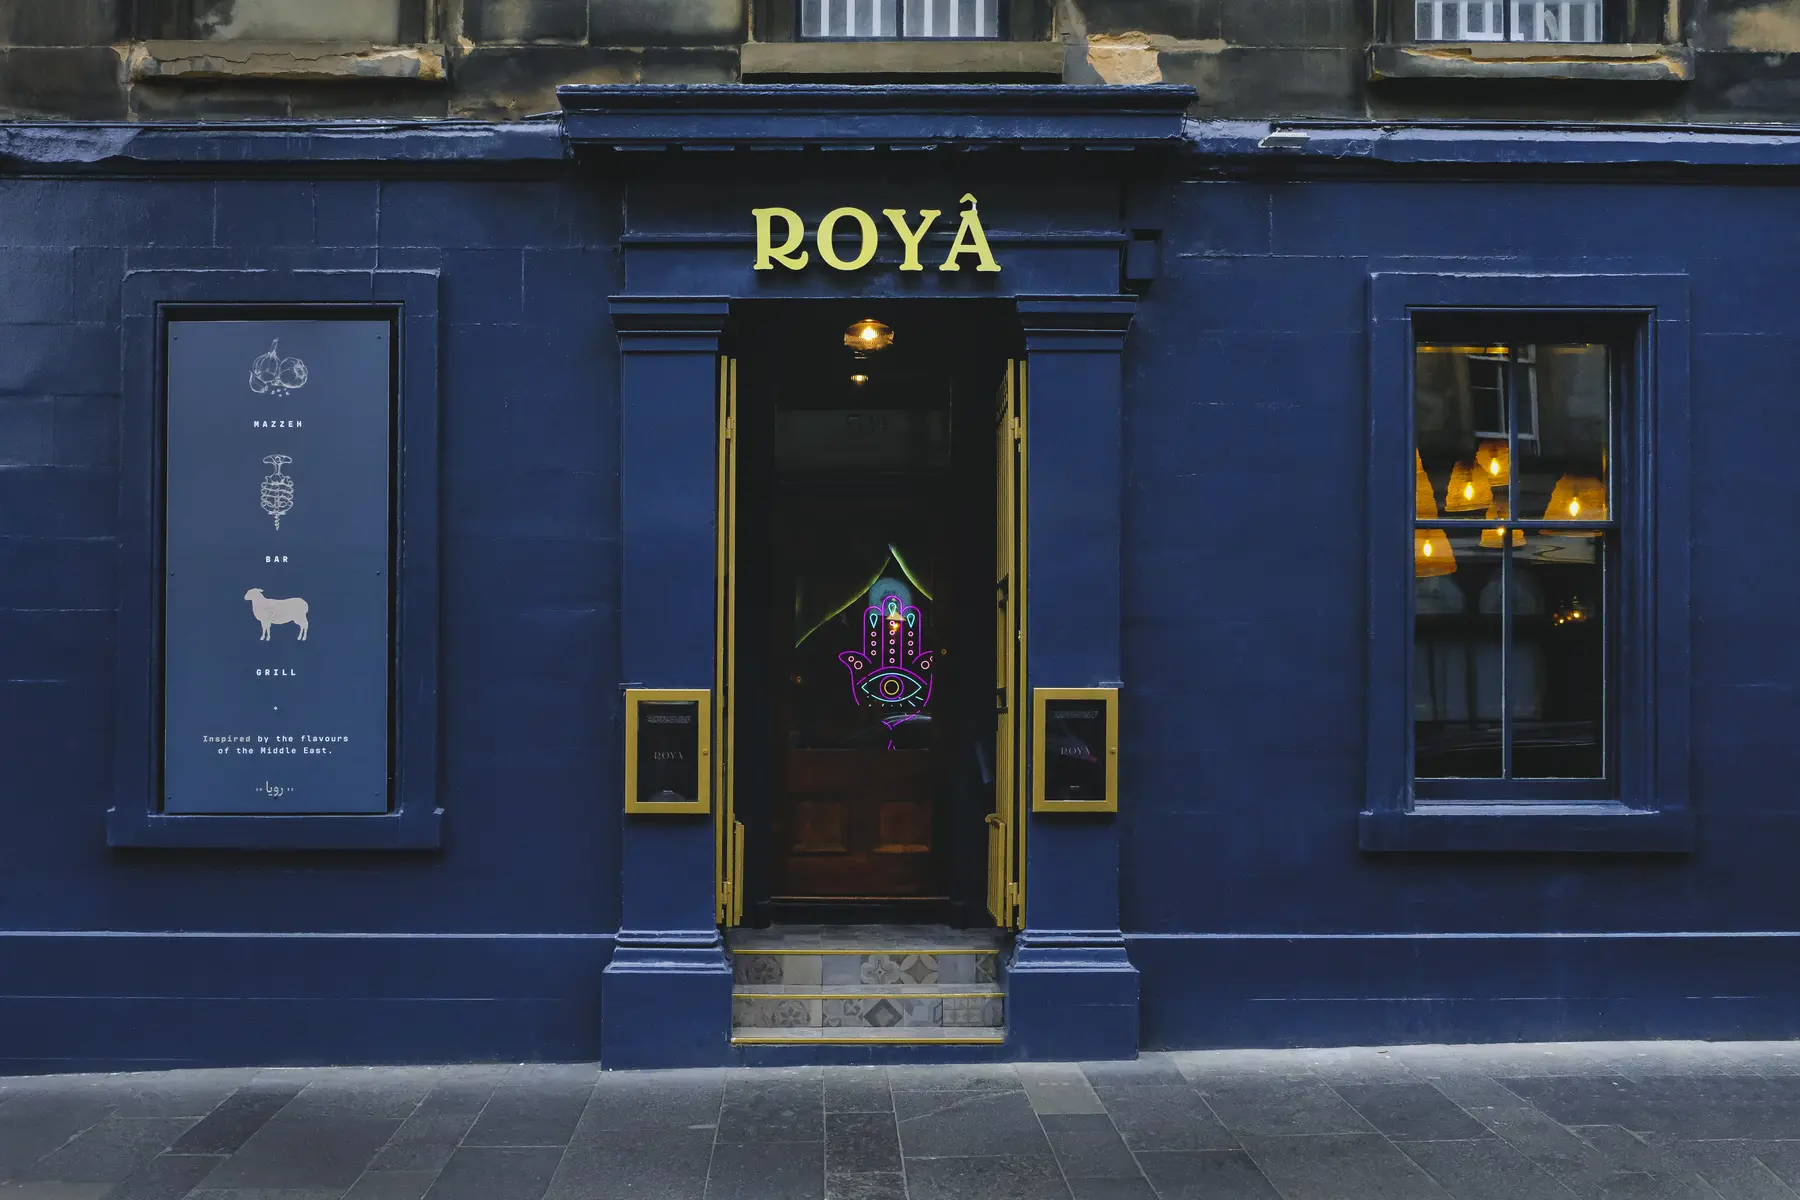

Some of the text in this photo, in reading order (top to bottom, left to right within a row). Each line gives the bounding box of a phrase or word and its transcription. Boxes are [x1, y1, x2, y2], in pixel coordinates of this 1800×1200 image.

[752, 193, 1002, 272] ROYÂ
[253, 420, 302, 428] MAZZEH
[265, 555, 289, 563] BAR
[256, 668, 296, 676] GRILL
[203, 735, 349, 744] Inspired by the flavours
[217, 746, 333, 755] of the Middle East.
